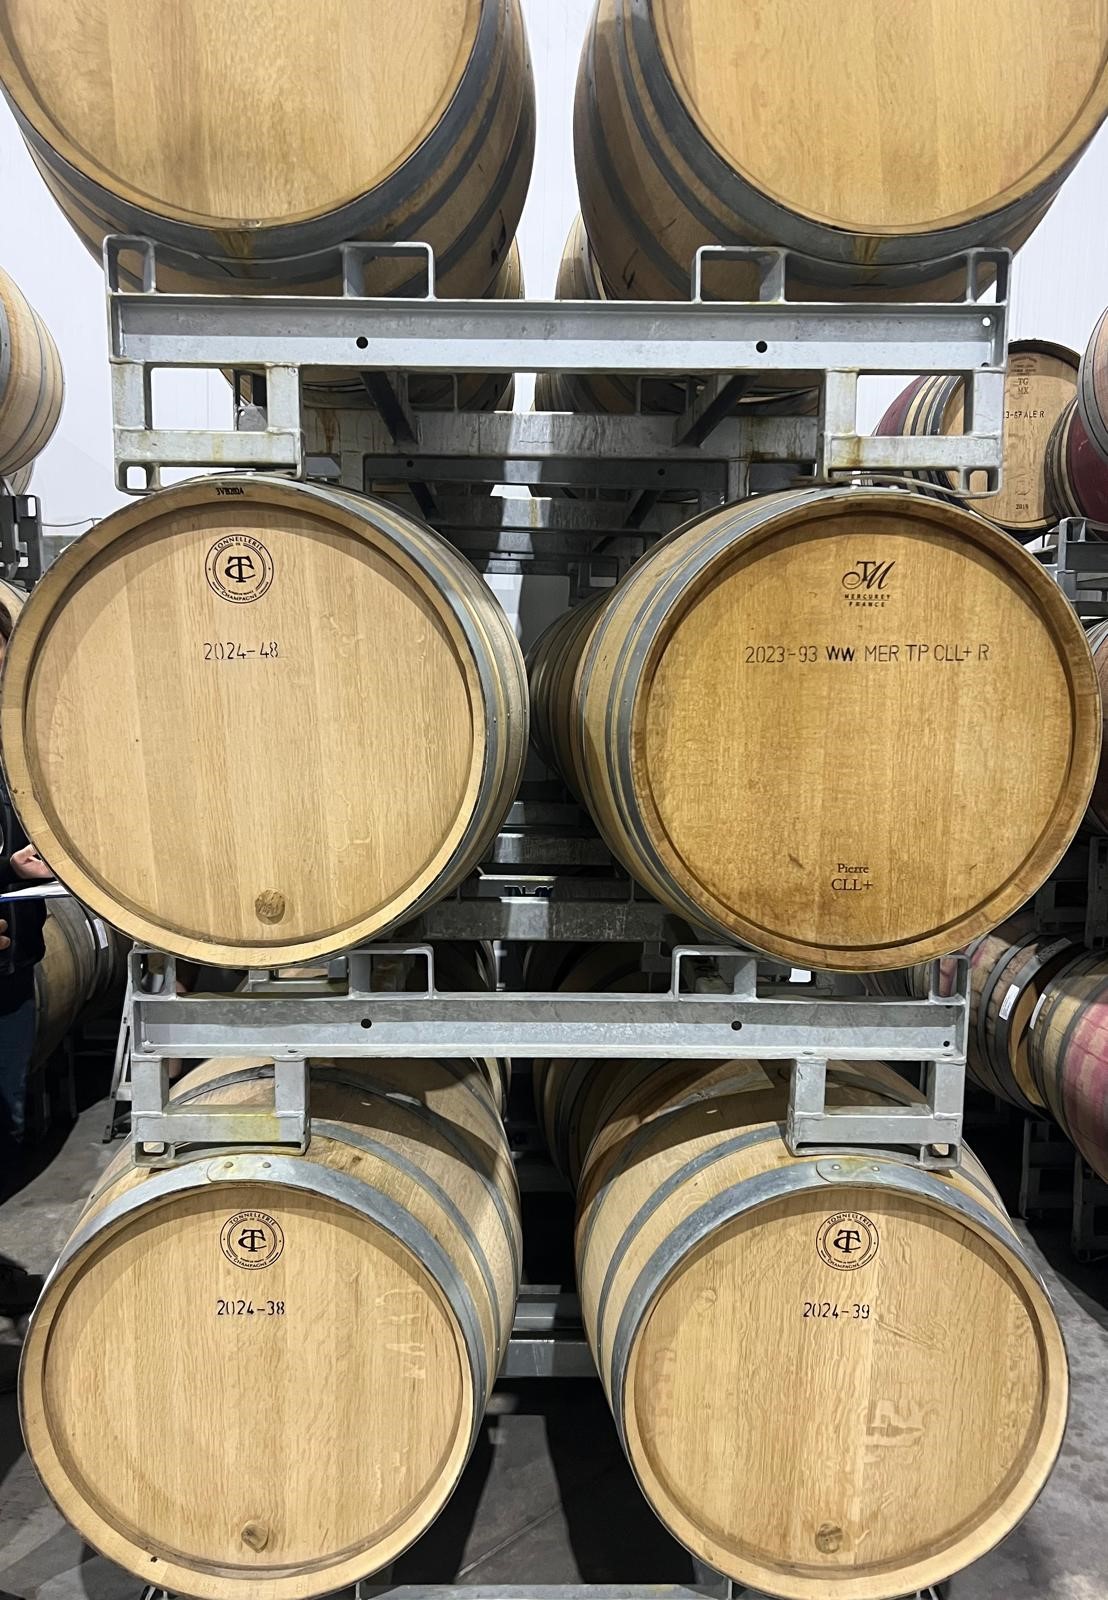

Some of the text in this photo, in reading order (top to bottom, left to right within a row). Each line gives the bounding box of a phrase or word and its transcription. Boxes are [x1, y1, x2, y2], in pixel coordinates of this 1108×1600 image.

[213, 536, 263, 552] TONNELLERIE
[221, 590, 258, 602] CHAMPAGNE
[203, 641, 279, 660] 2024-48
[745, 645, 818, 664] 2023-93
[864, 644, 900, 662] MER
[905, 643, 930, 662] TP
[933, 644, 973, 662] CLL+
[977, 644, 990, 662] R
[837, 862, 870, 874] Pierre
[229, 1212, 277, 1227] TONNELLERIE
[826, 1213, 873, 1229] TONNELLERIE
[233, 1258, 268, 1268] CHAMPAGNE
[827, 1258, 861, 1269] CHAMPAGNE
[216, 1299, 285, 1316] 2024-38
[803, 1302, 870, 1320] 2024-39
